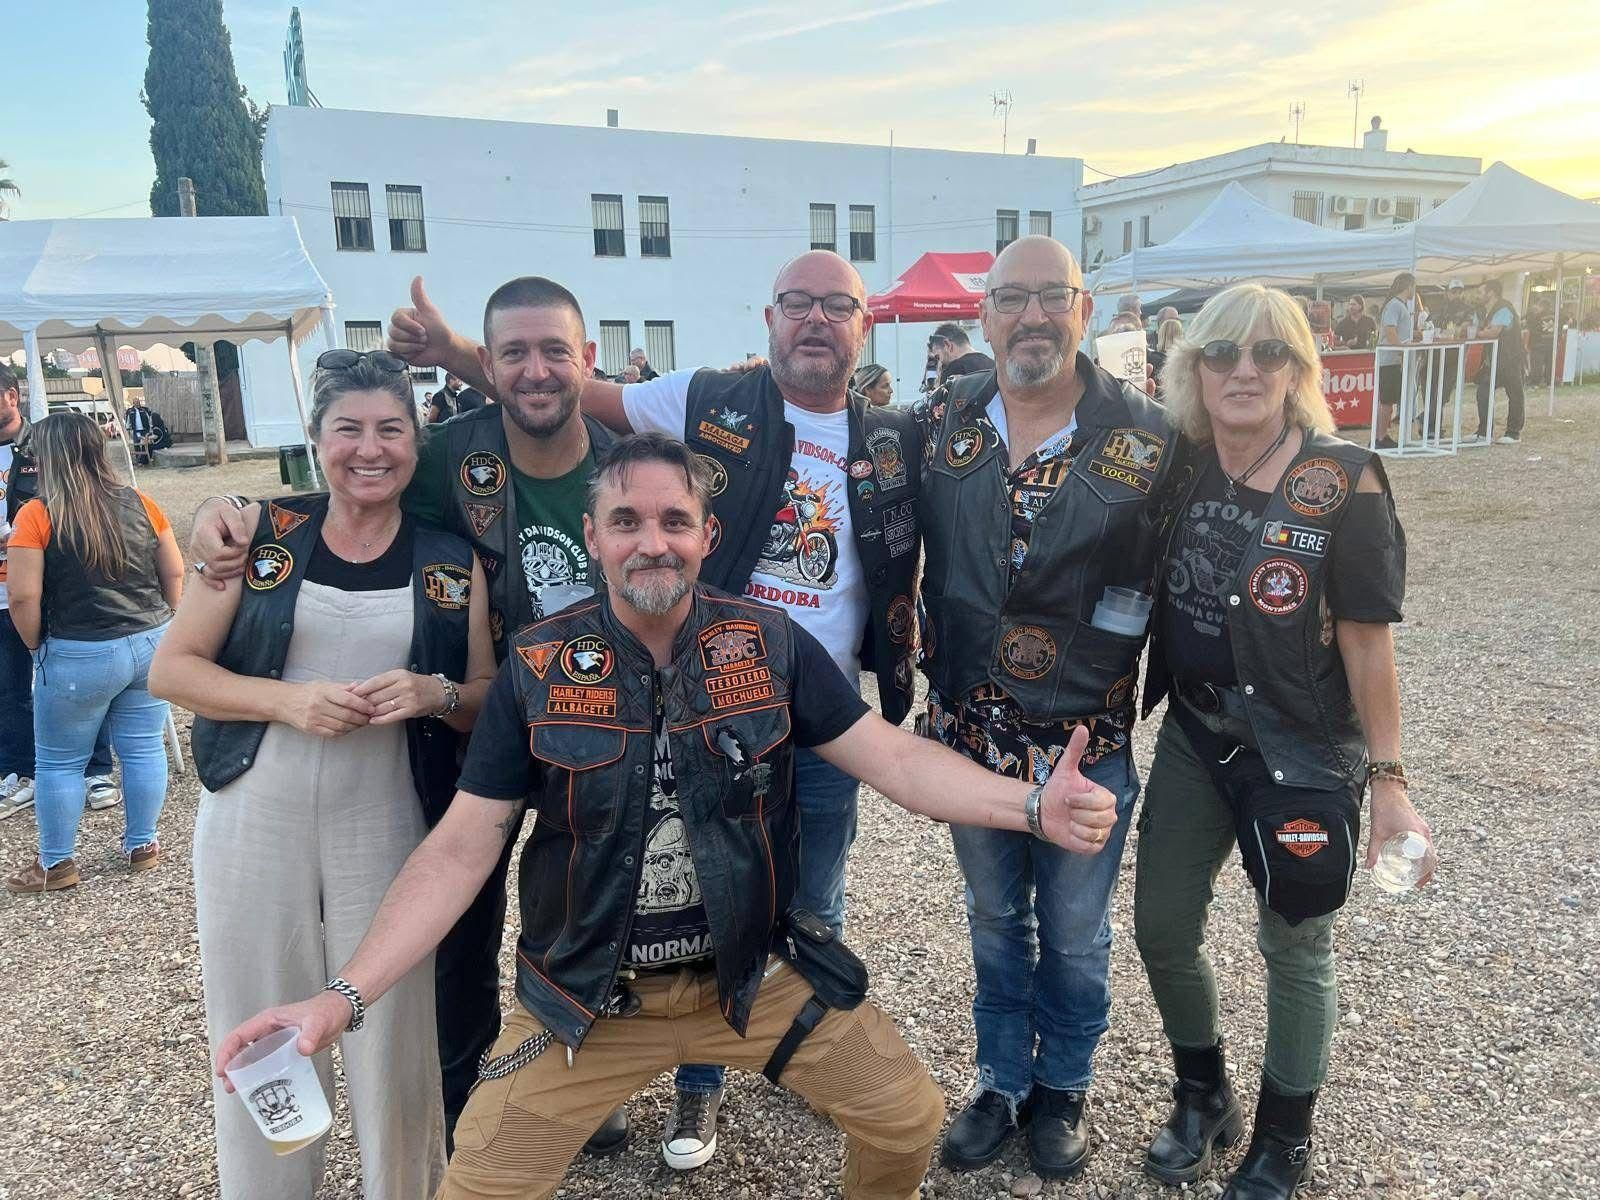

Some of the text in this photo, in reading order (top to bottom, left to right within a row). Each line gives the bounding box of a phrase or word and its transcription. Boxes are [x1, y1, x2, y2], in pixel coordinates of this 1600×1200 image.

[471, 456, 495, 466] HDC
[1101, 466, 1141, 486] VOCAL
[524, 525, 573, 548] DAVIDSON
[570, 544, 588, 569] CLUB
[1292, 530, 1326, 552] TERE
[258, 549, 287, 560] HDC
[575, 572, 588, 580] 20
[701, 623, 757, 642] HARLEY DAVIDSON
[576, 641, 605, 651] HDC
[572, 671, 601, 681] ESPAÑA
[709, 670, 767, 690] TESORERO
[553, 687, 614, 700] HARLEY RIDERS
[717, 686, 769, 706] MOCHUELO
[554, 702, 609, 714] ALBACETE
[1277, 833, 1328, 842] HARLEY-DAVIDSON
